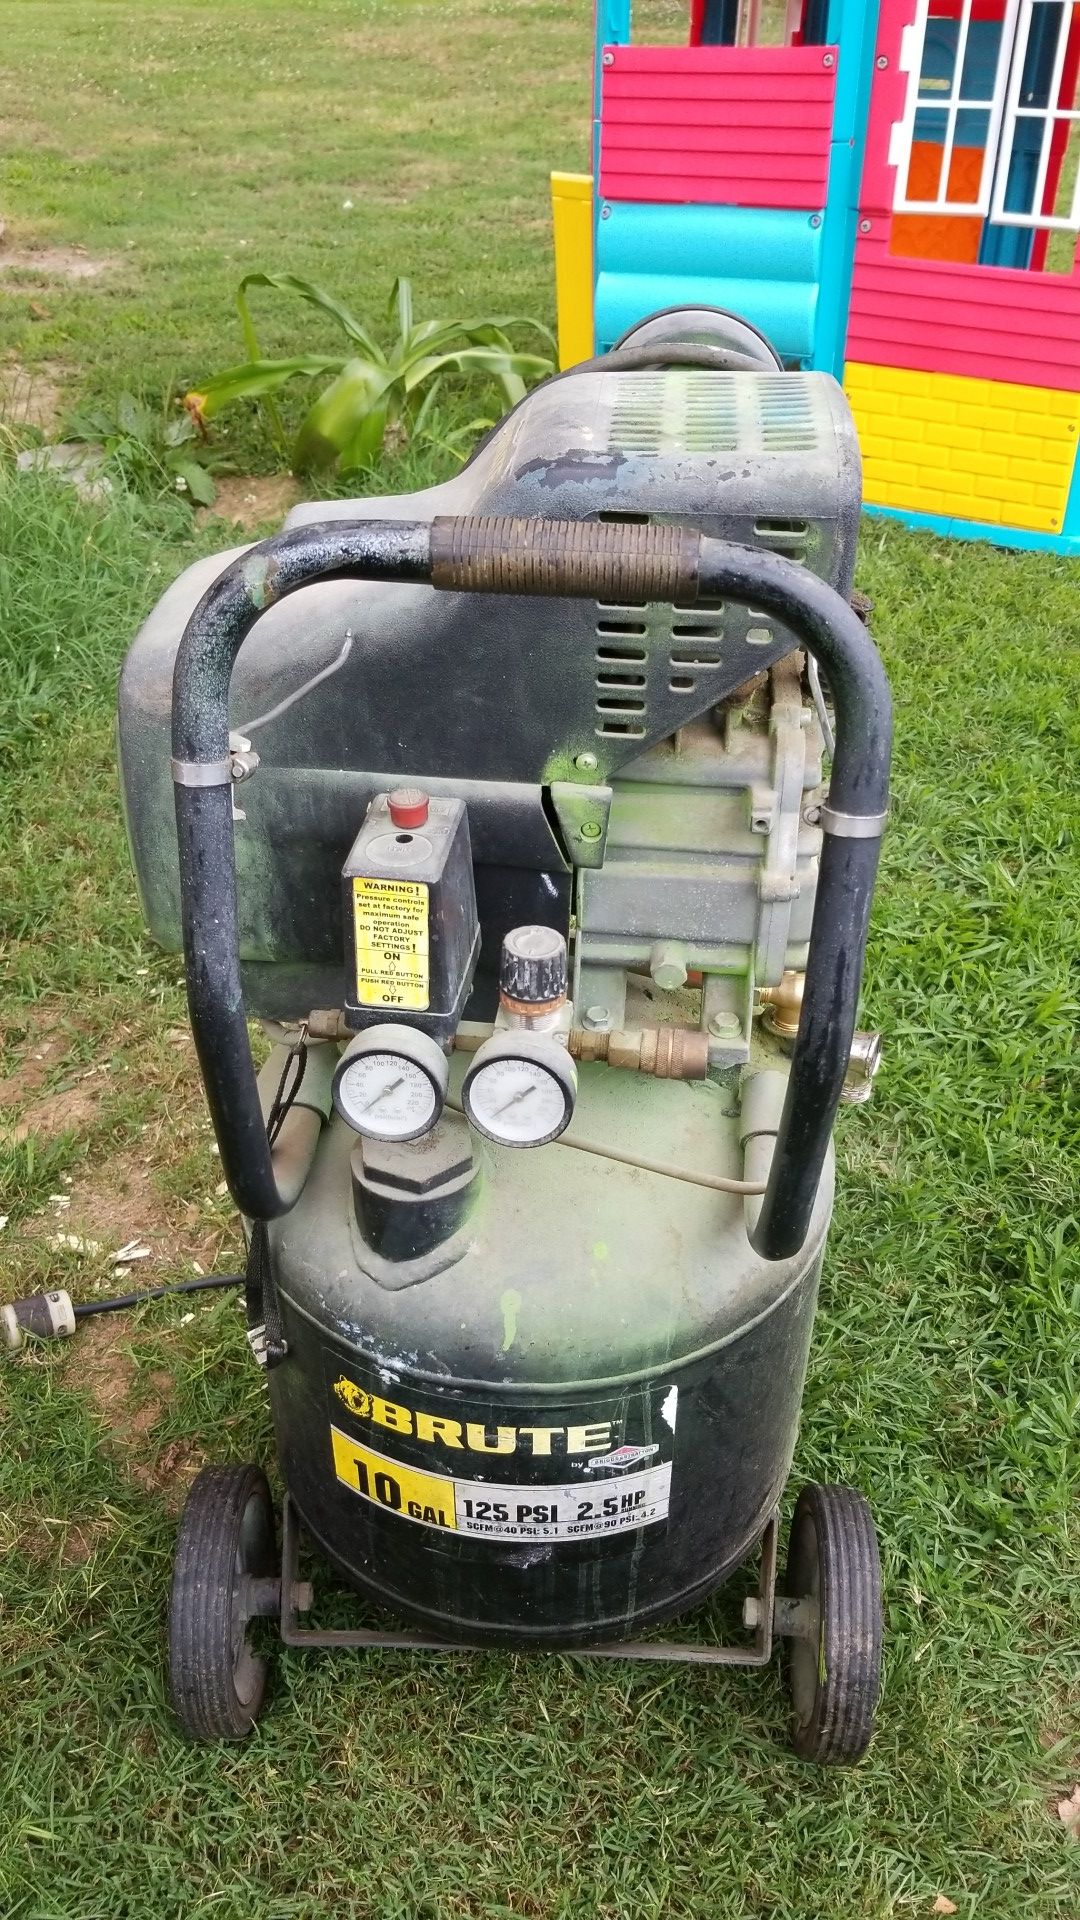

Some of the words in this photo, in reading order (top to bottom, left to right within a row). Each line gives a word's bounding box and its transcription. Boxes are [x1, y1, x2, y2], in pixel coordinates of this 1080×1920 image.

[356, 894, 390, 902] Pressure
[393, 898, 424, 906] controls
[382, 904, 410, 913] factory
[363, 910, 400, 918] maximum
[373, 920, 410, 928] operation
[392, 928, 424, 936] ADJUST
[373, 934, 410, 942] FACTORY
[384, 952, 400, 960] ON
[382, 994, 404, 1003] OFF
[371, 1394, 612, 1455] BRUTE
[354, 1458, 402, 1510] 10
[407, 1501, 450, 1528] GAL
[463, 1500, 508, 1521] 125
[517, 1505, 558, 1523] PSI
[578, 1497, 618, 1520] 2.5
[621, 1490, 646, 1508] HP
[466, 1522, 517, 1534] SCFM@40
[567, 1520, 616, 1533] SCFM@90
[641, 1508, 655, 1518] 4.2
